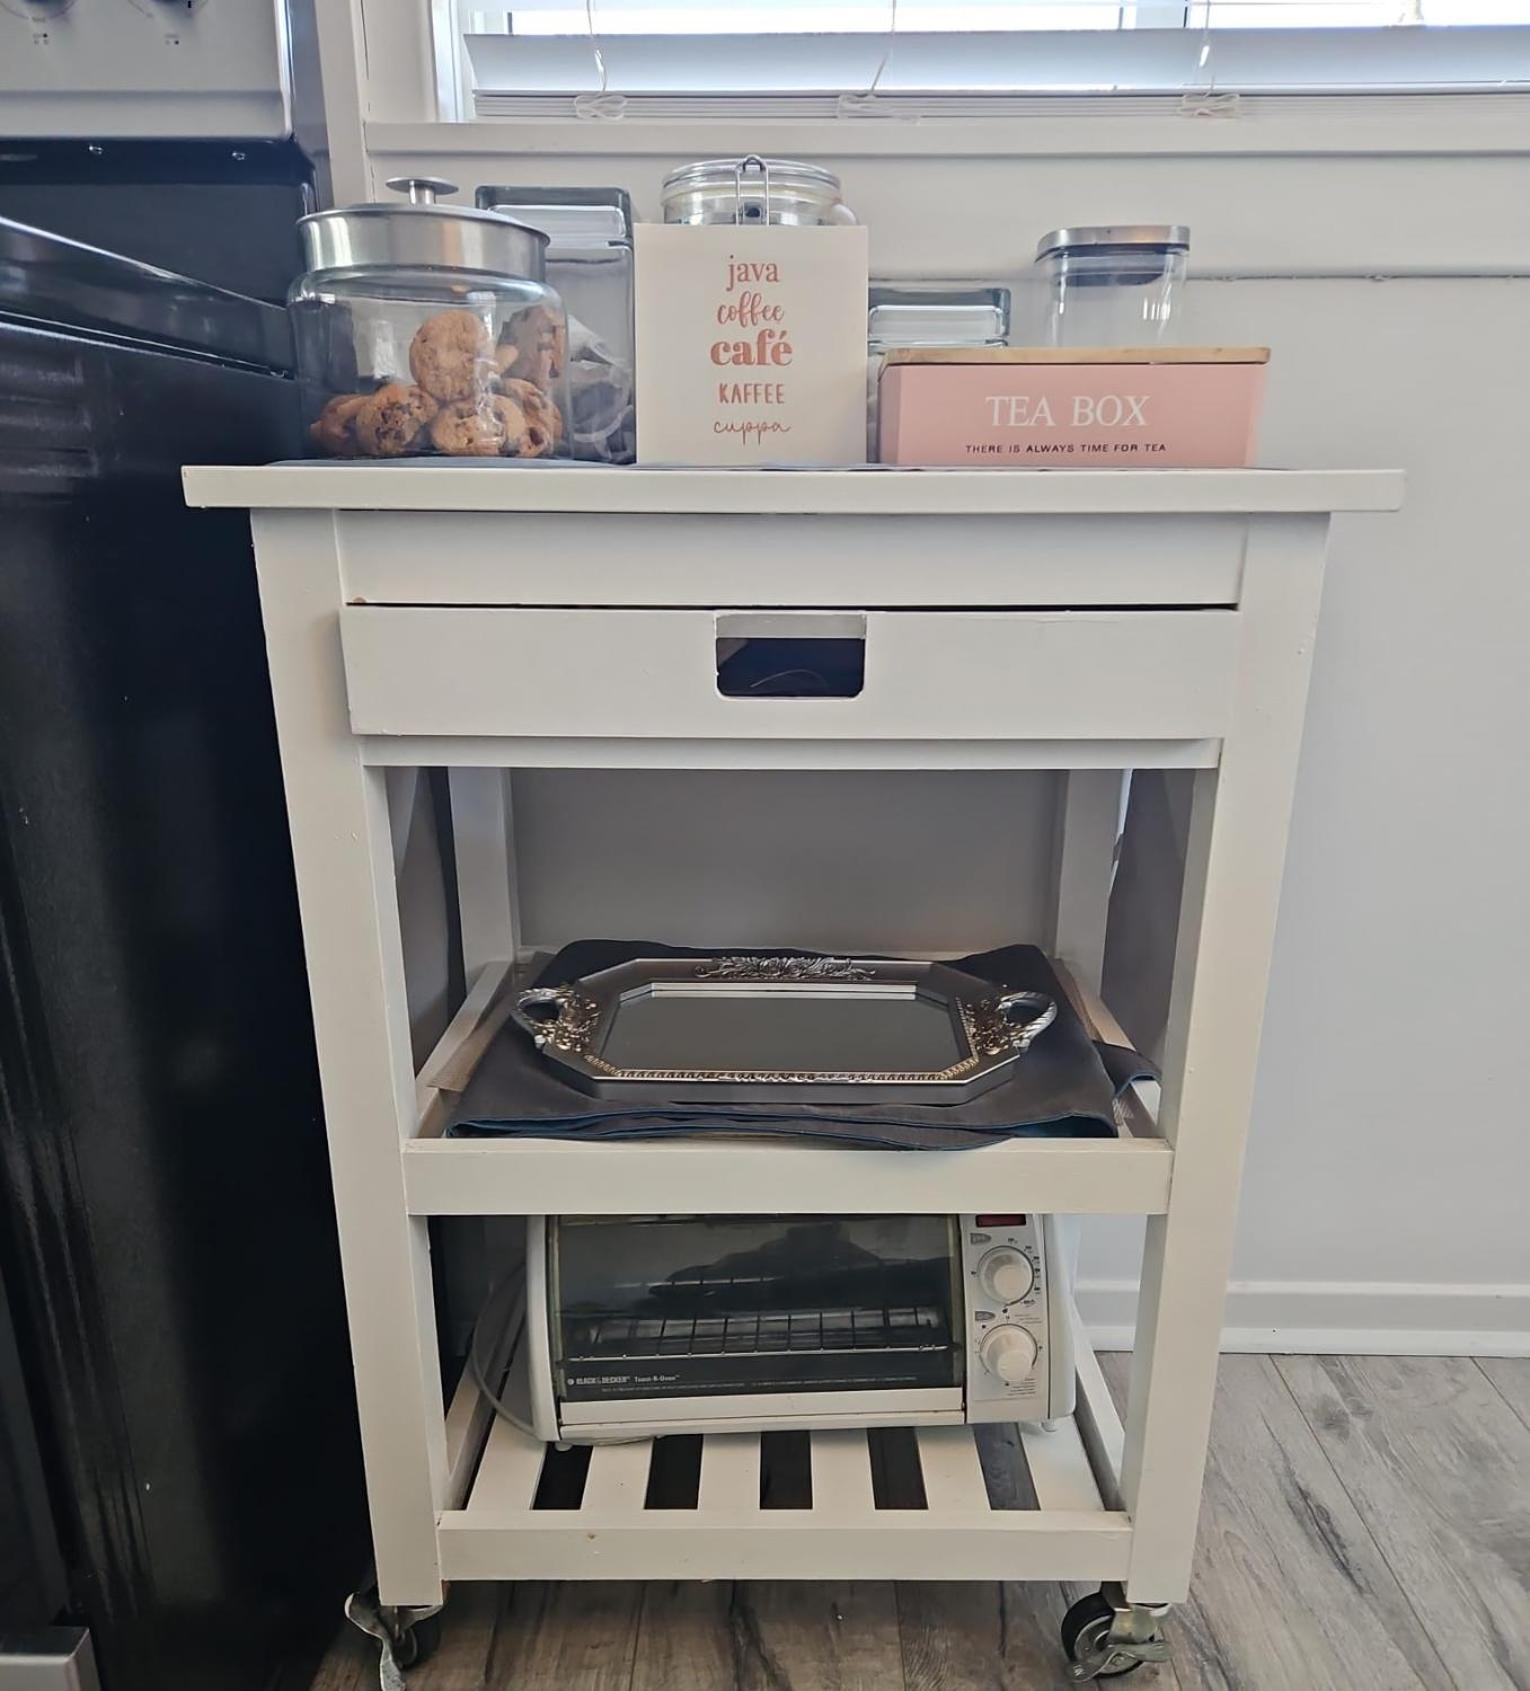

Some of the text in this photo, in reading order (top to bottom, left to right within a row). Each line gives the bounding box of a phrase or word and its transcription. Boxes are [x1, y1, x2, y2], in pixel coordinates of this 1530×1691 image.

[726, 255, 779, 292] java
[717, 291, 785, 328] coffee
[710, 328, 793, 366] café
[719, 383, 785, 404] KAFFEE
[985, 395, 1150, 426] TEA BOX
[713, 421, 790, 446] cuppa
[966, 443, 1167, 453] THERE IS ALWAYS TIME FOR TEA
